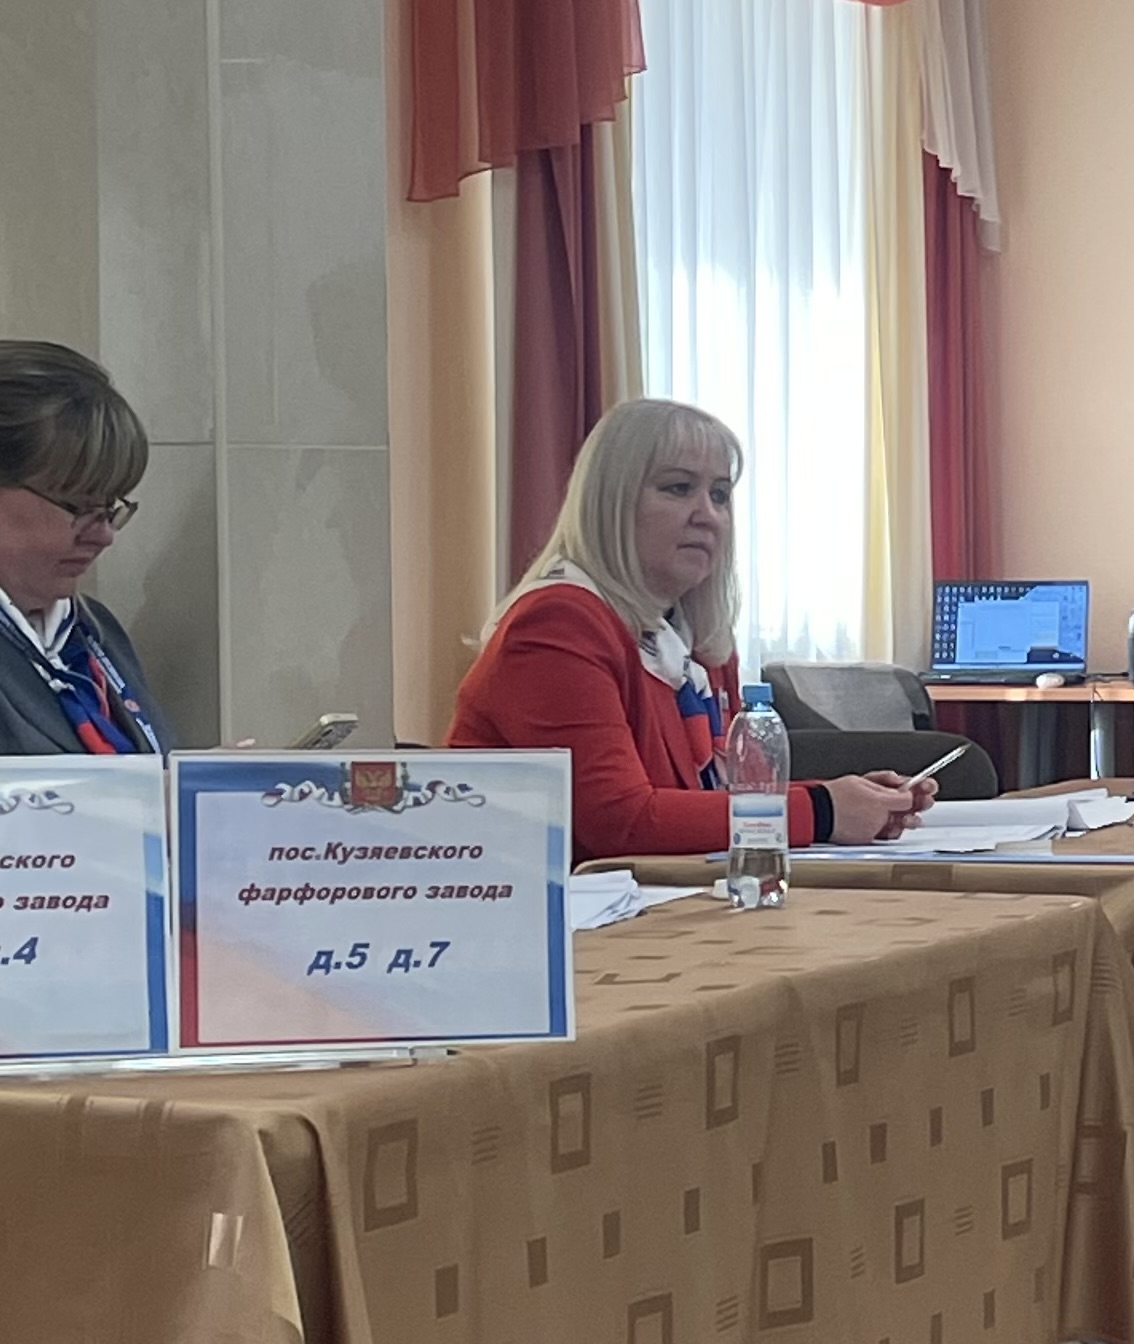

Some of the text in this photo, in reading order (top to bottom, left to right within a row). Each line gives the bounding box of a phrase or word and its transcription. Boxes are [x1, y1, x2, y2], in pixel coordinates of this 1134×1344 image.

[268, 842, 483, 865] пос.Кузяевского
[13, 894, 110, 912] завода
[238, 882, 513, 905] фарфорового завода
[306, 940, 451, 976] д.5 д.7
